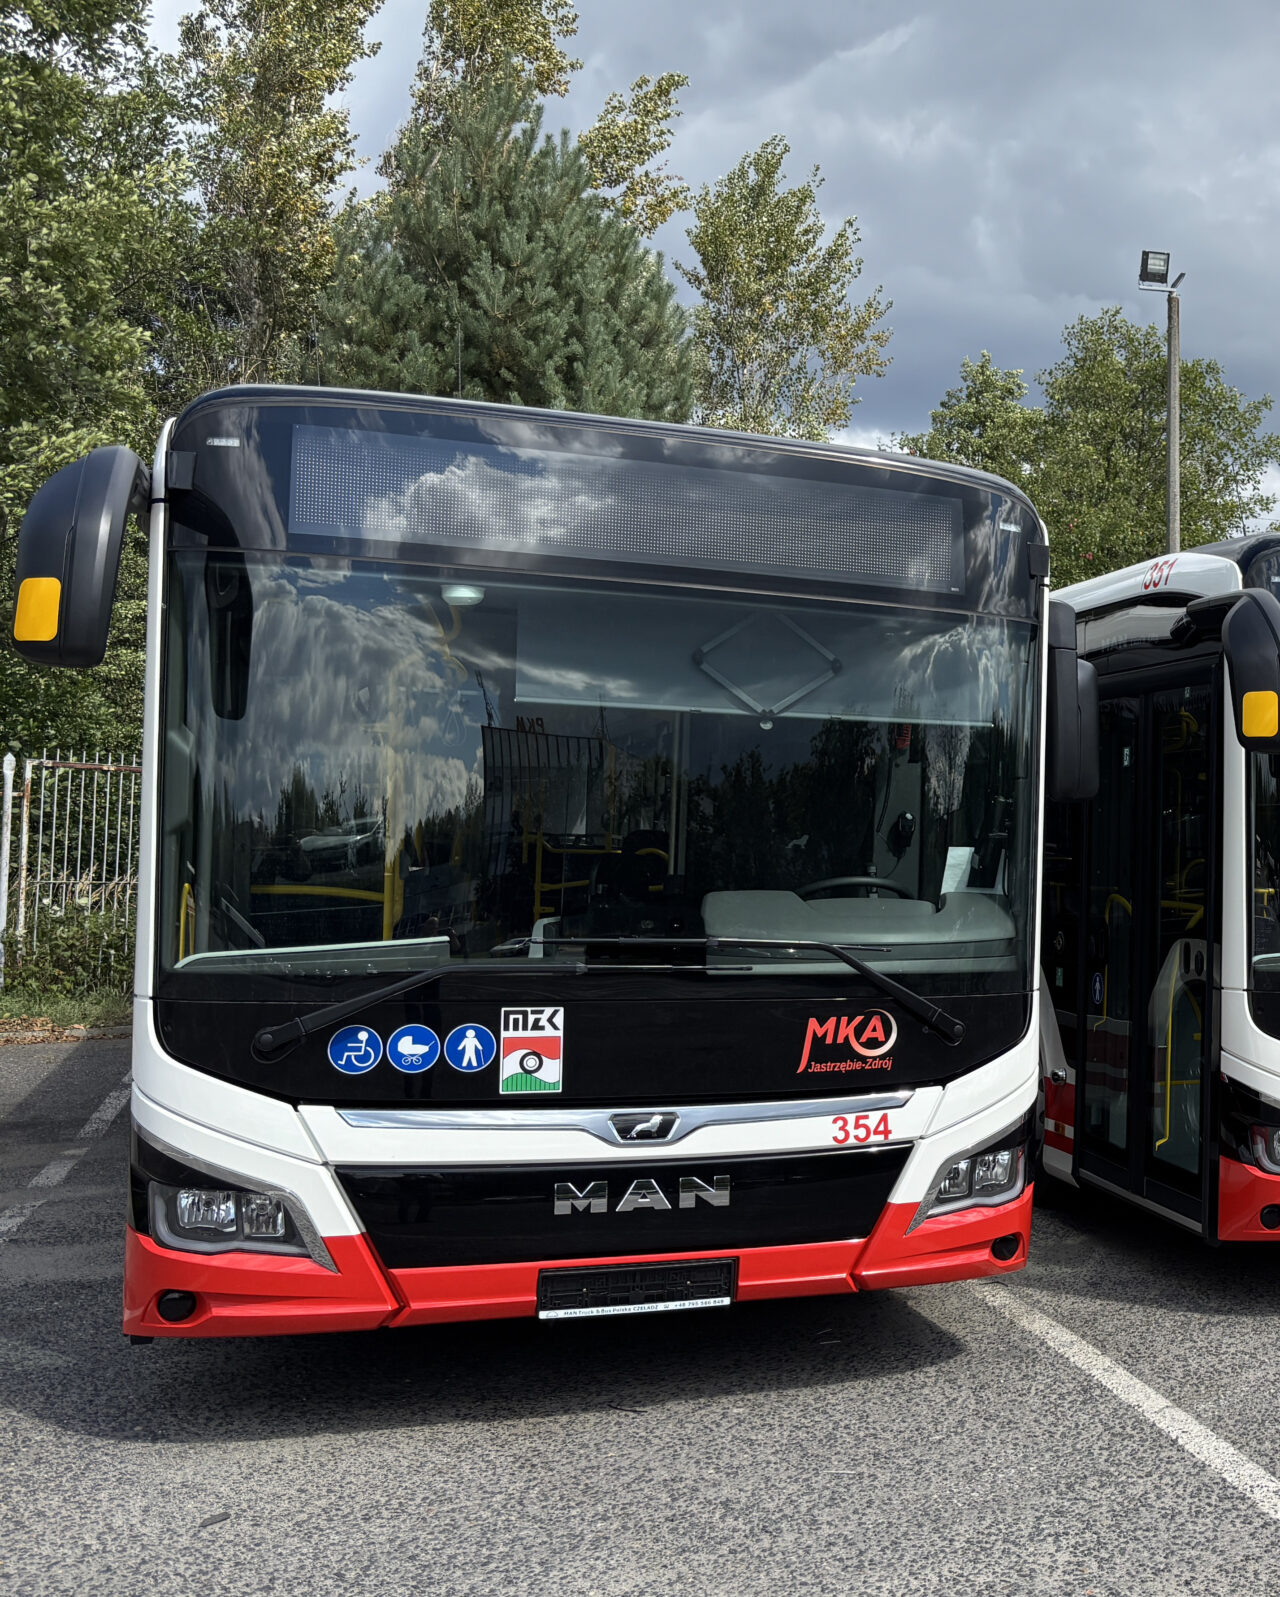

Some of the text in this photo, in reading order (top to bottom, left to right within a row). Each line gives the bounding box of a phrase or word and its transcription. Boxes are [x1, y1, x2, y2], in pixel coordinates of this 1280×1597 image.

[1144, 558, 1178, 590] 351
[503, 1009, 560, 1031] MZK
[796, 1008, 898, 1073] MKA
[808, 1057, 893, 1074] Jastrzębie-Zdrój
[832, 1113, 892, 1144] 354
[554, 1175, 730, 1215] MAN
